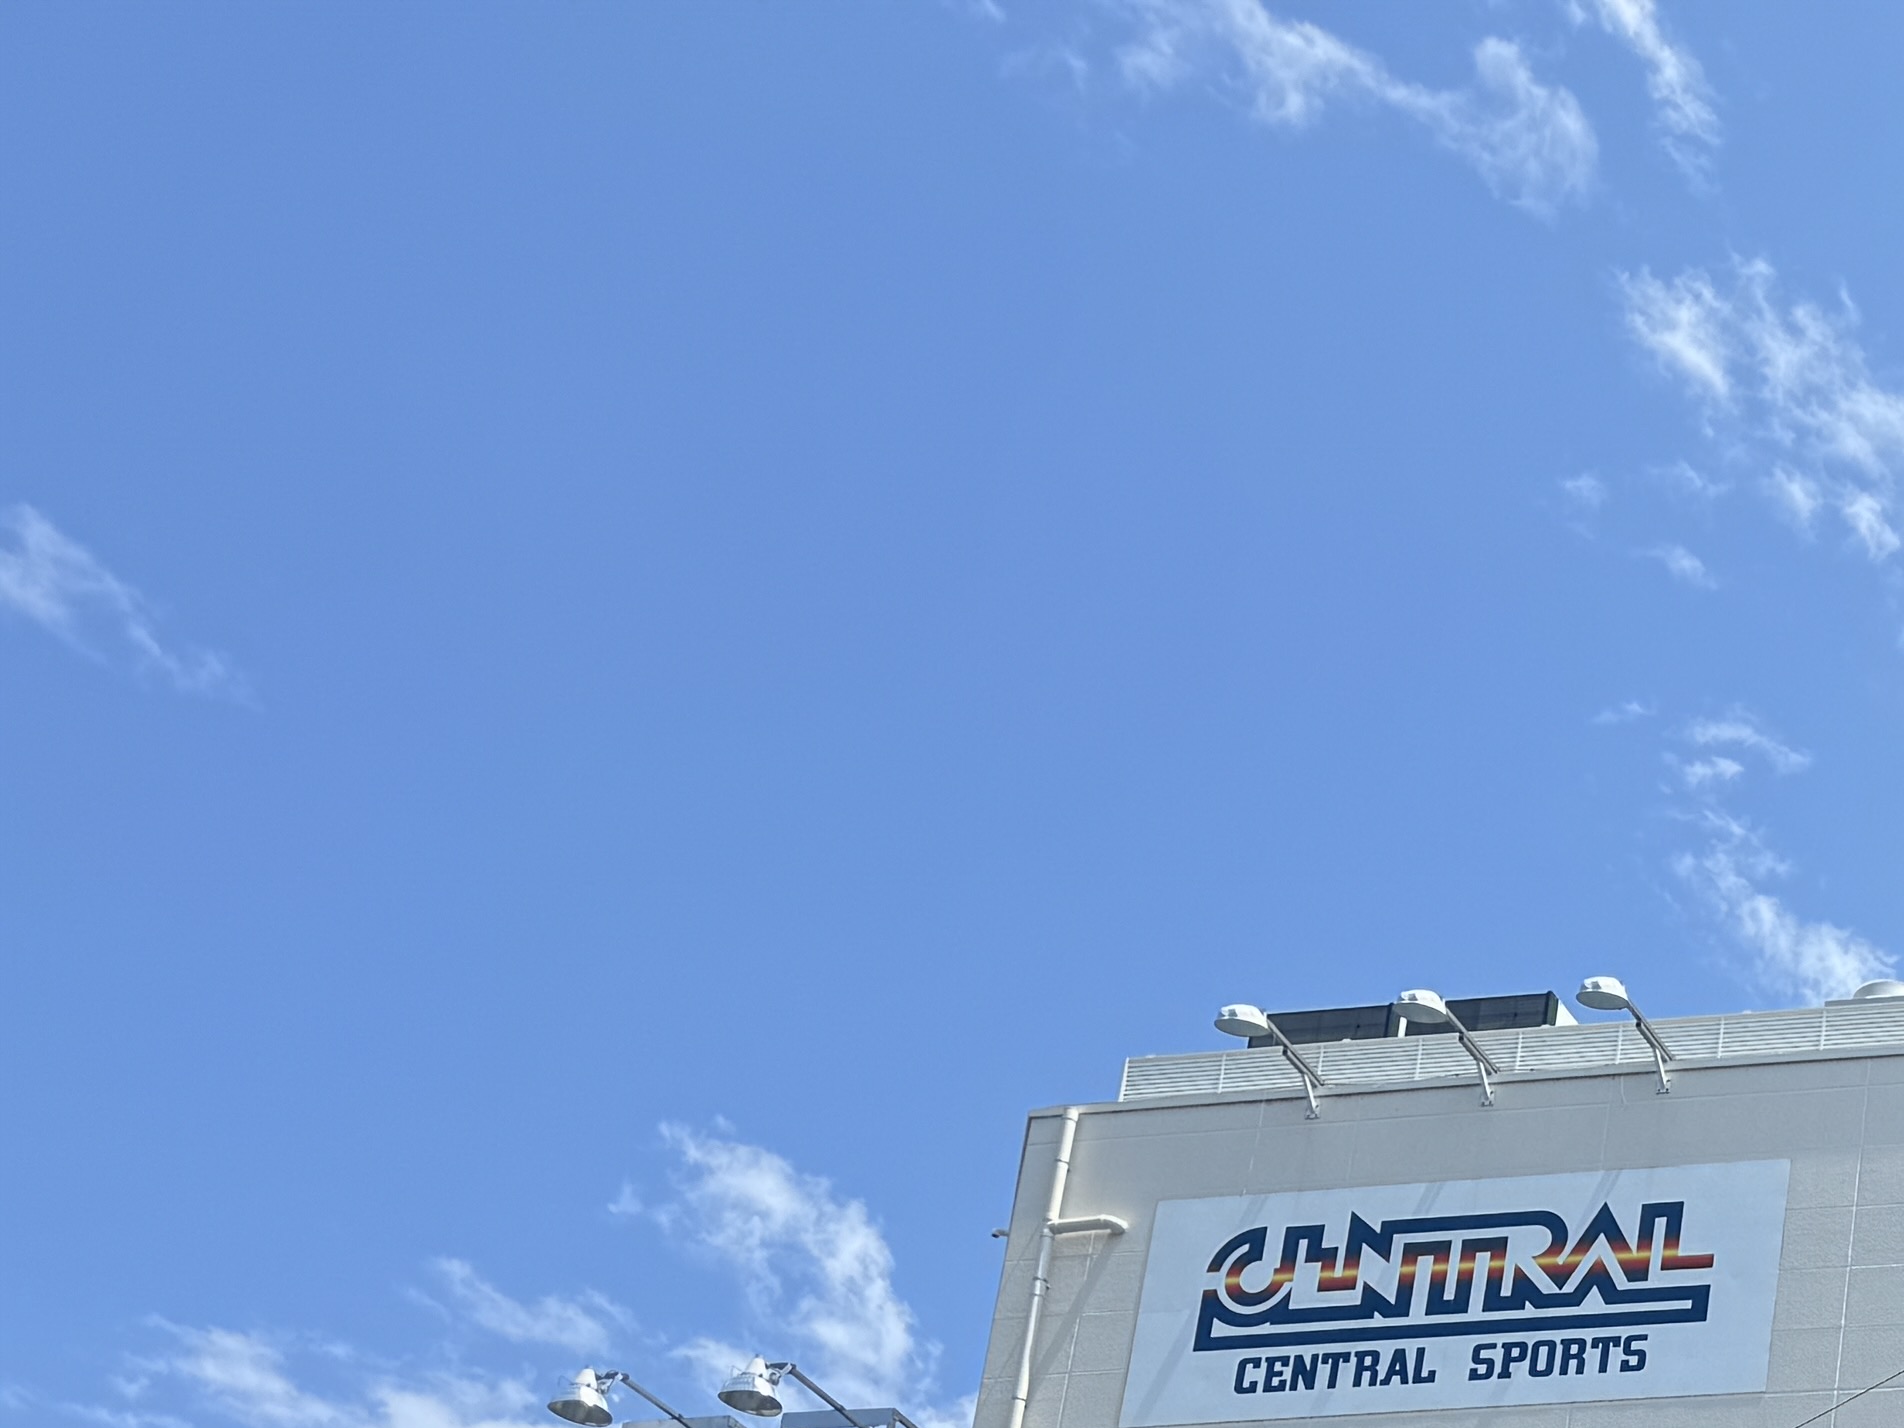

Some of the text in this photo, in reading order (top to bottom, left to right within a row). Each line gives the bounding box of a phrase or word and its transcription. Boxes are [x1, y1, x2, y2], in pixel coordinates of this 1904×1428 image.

[1194, 1201, 1714, 1351] CENTRAL
[1233, 1335, 1649, 1394] CENTRAL SPORTS
